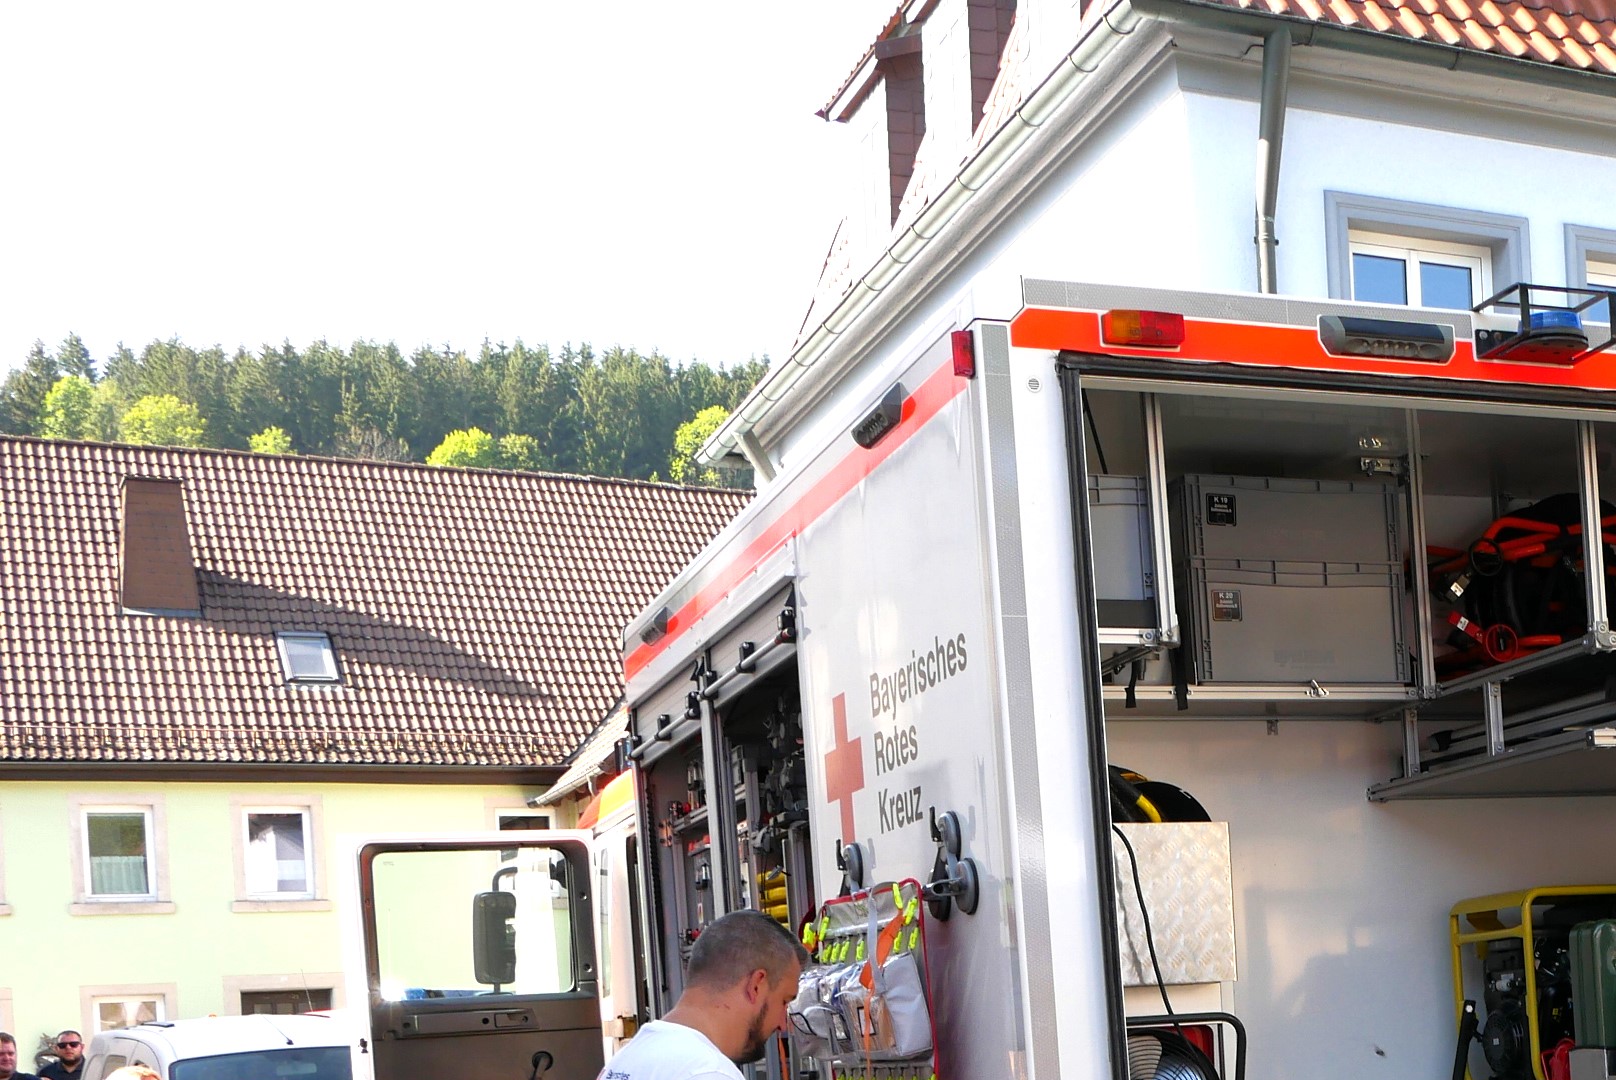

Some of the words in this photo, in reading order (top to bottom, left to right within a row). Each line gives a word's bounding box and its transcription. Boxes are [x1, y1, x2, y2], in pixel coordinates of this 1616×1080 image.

[869, 632, 967, 720] Bayerisches
[873, 725, 918, 776] Rotes
[878, 785, 923, 834] Kreuz
